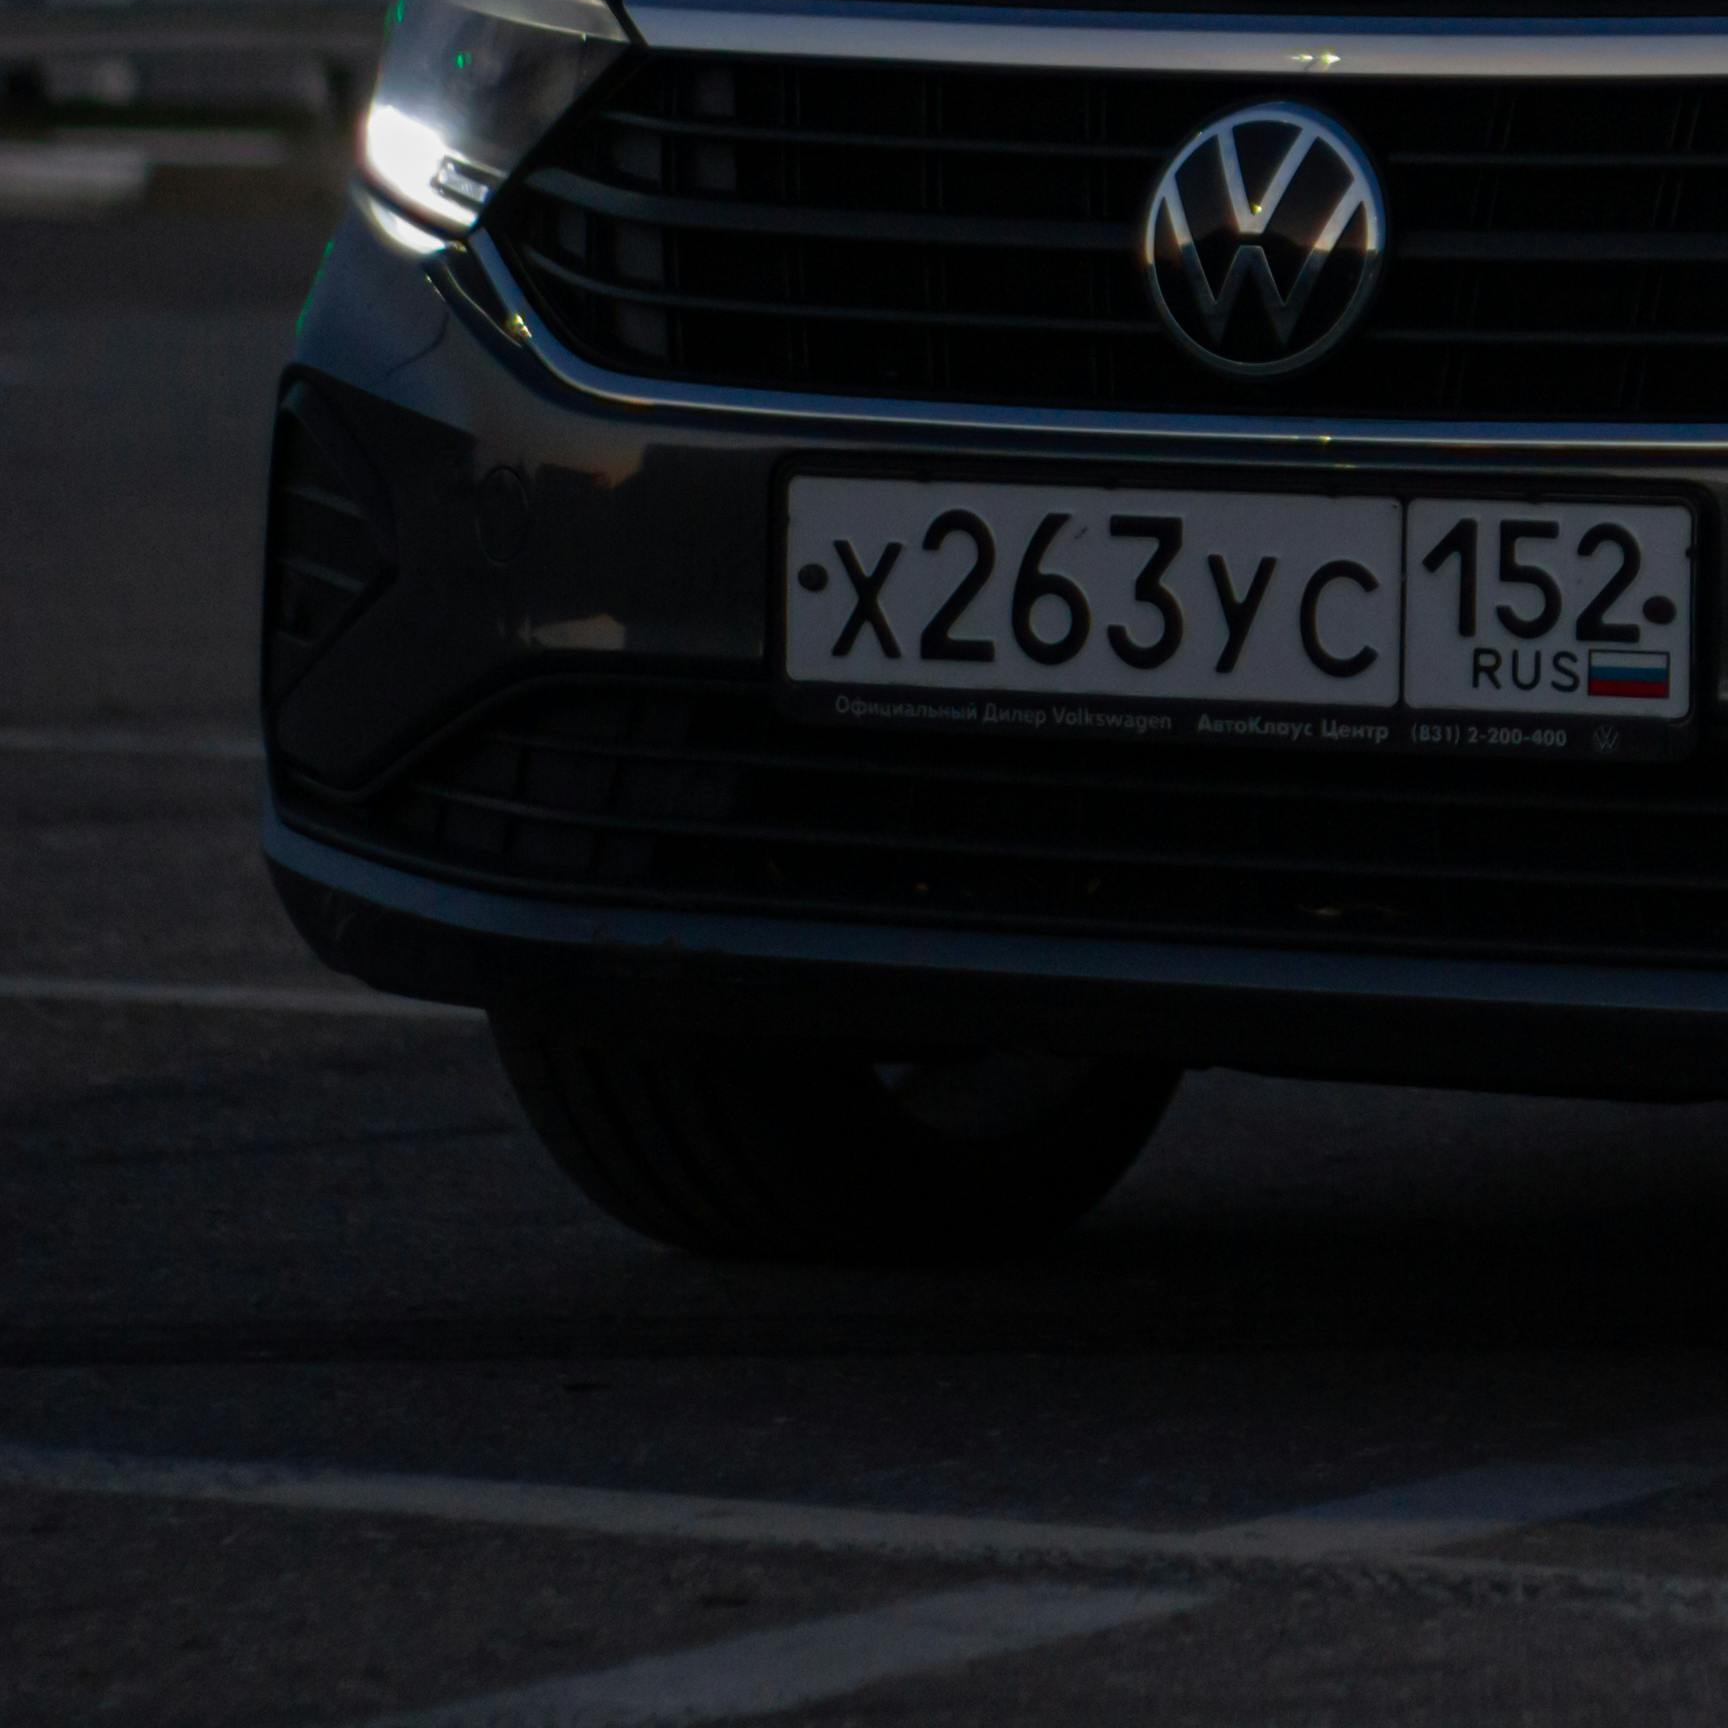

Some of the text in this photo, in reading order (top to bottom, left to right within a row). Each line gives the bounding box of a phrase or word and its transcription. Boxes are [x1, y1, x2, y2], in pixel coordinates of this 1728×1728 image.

[1423, 519, 1641, 644] 152
[1472, 648, 1581, 694] RUS
[834, 694, 1172, 734] Официальный Дилер Volkswagen
[1198, 712, 1390, 744] АвтоКлаус Центр
[1410, 721, 1568, 748] (831) 2-200-400
